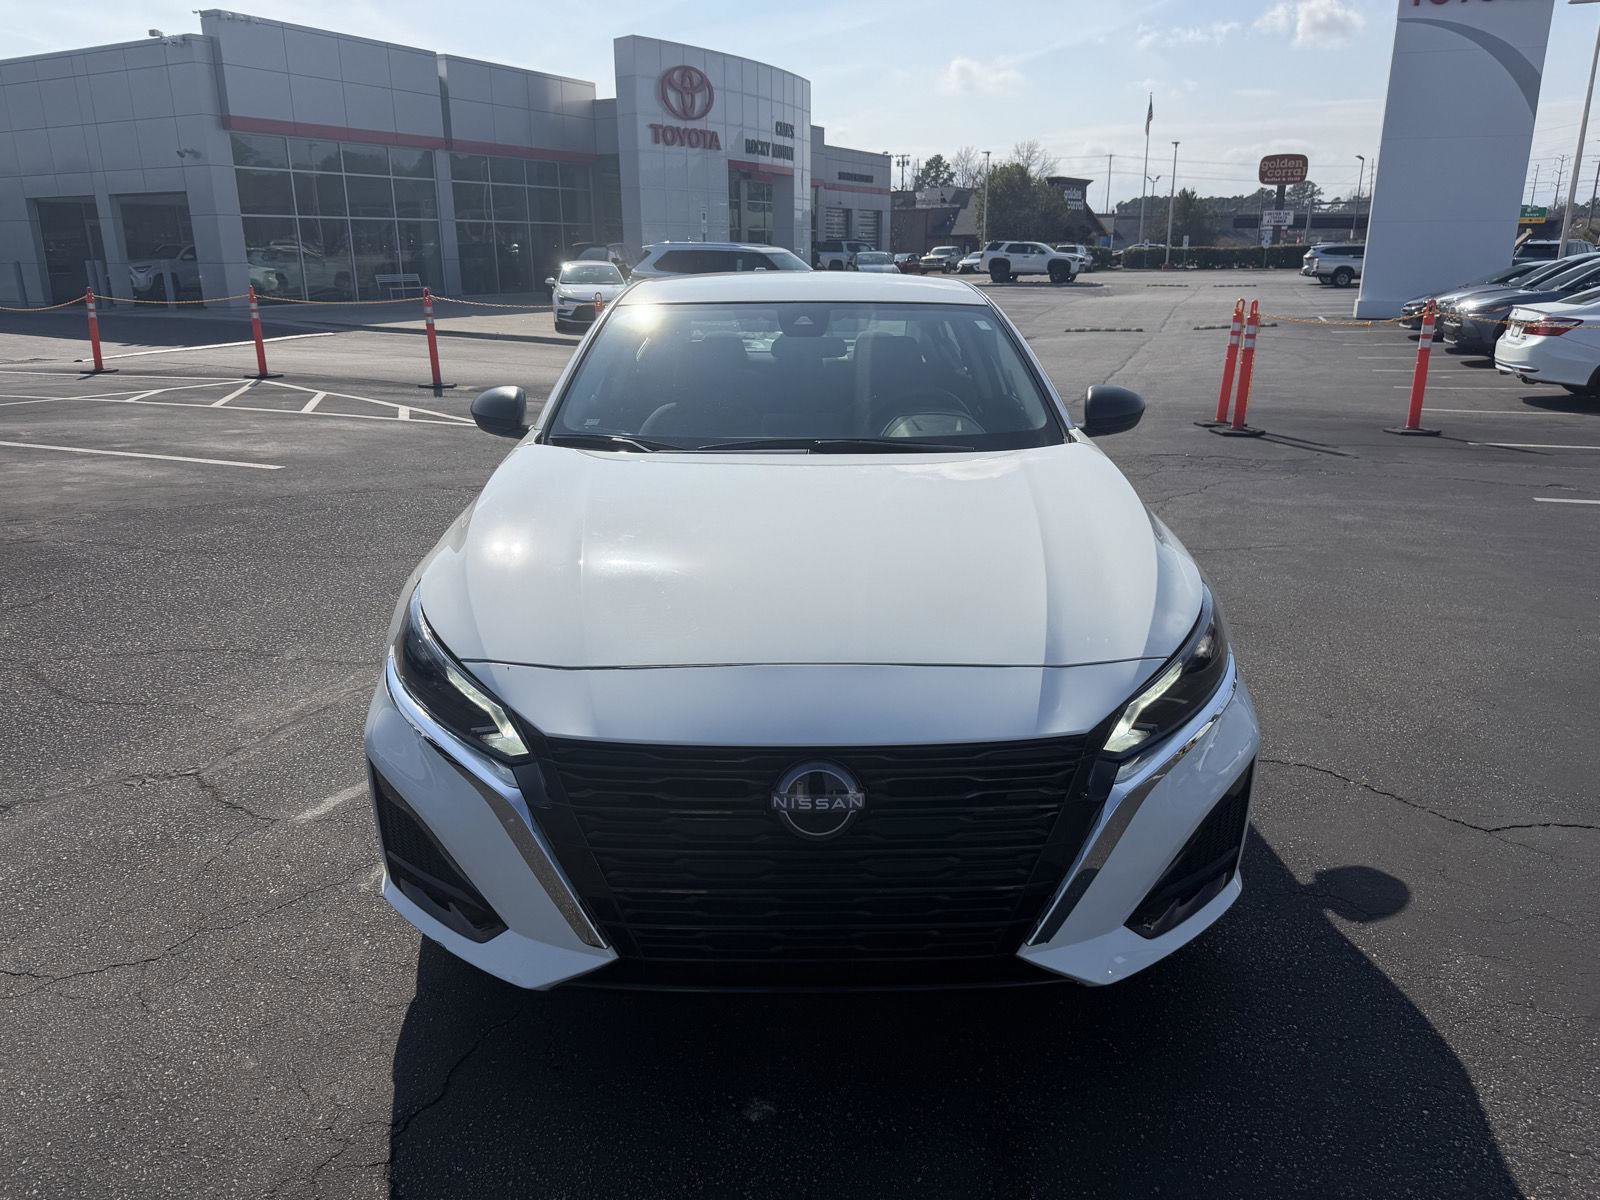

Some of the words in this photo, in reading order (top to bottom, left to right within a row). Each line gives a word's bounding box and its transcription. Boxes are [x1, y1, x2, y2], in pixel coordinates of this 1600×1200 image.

[648, 123, 722, 150] TOYOTA
[745, 138, 771, 157] ROCKY
[771, 142, 795, 161] MOUNT
[1261, 158, 1303, 171] golden
[1266, 166, 1306, 177] corral
[773, 795, 863, 810] NISSAN
